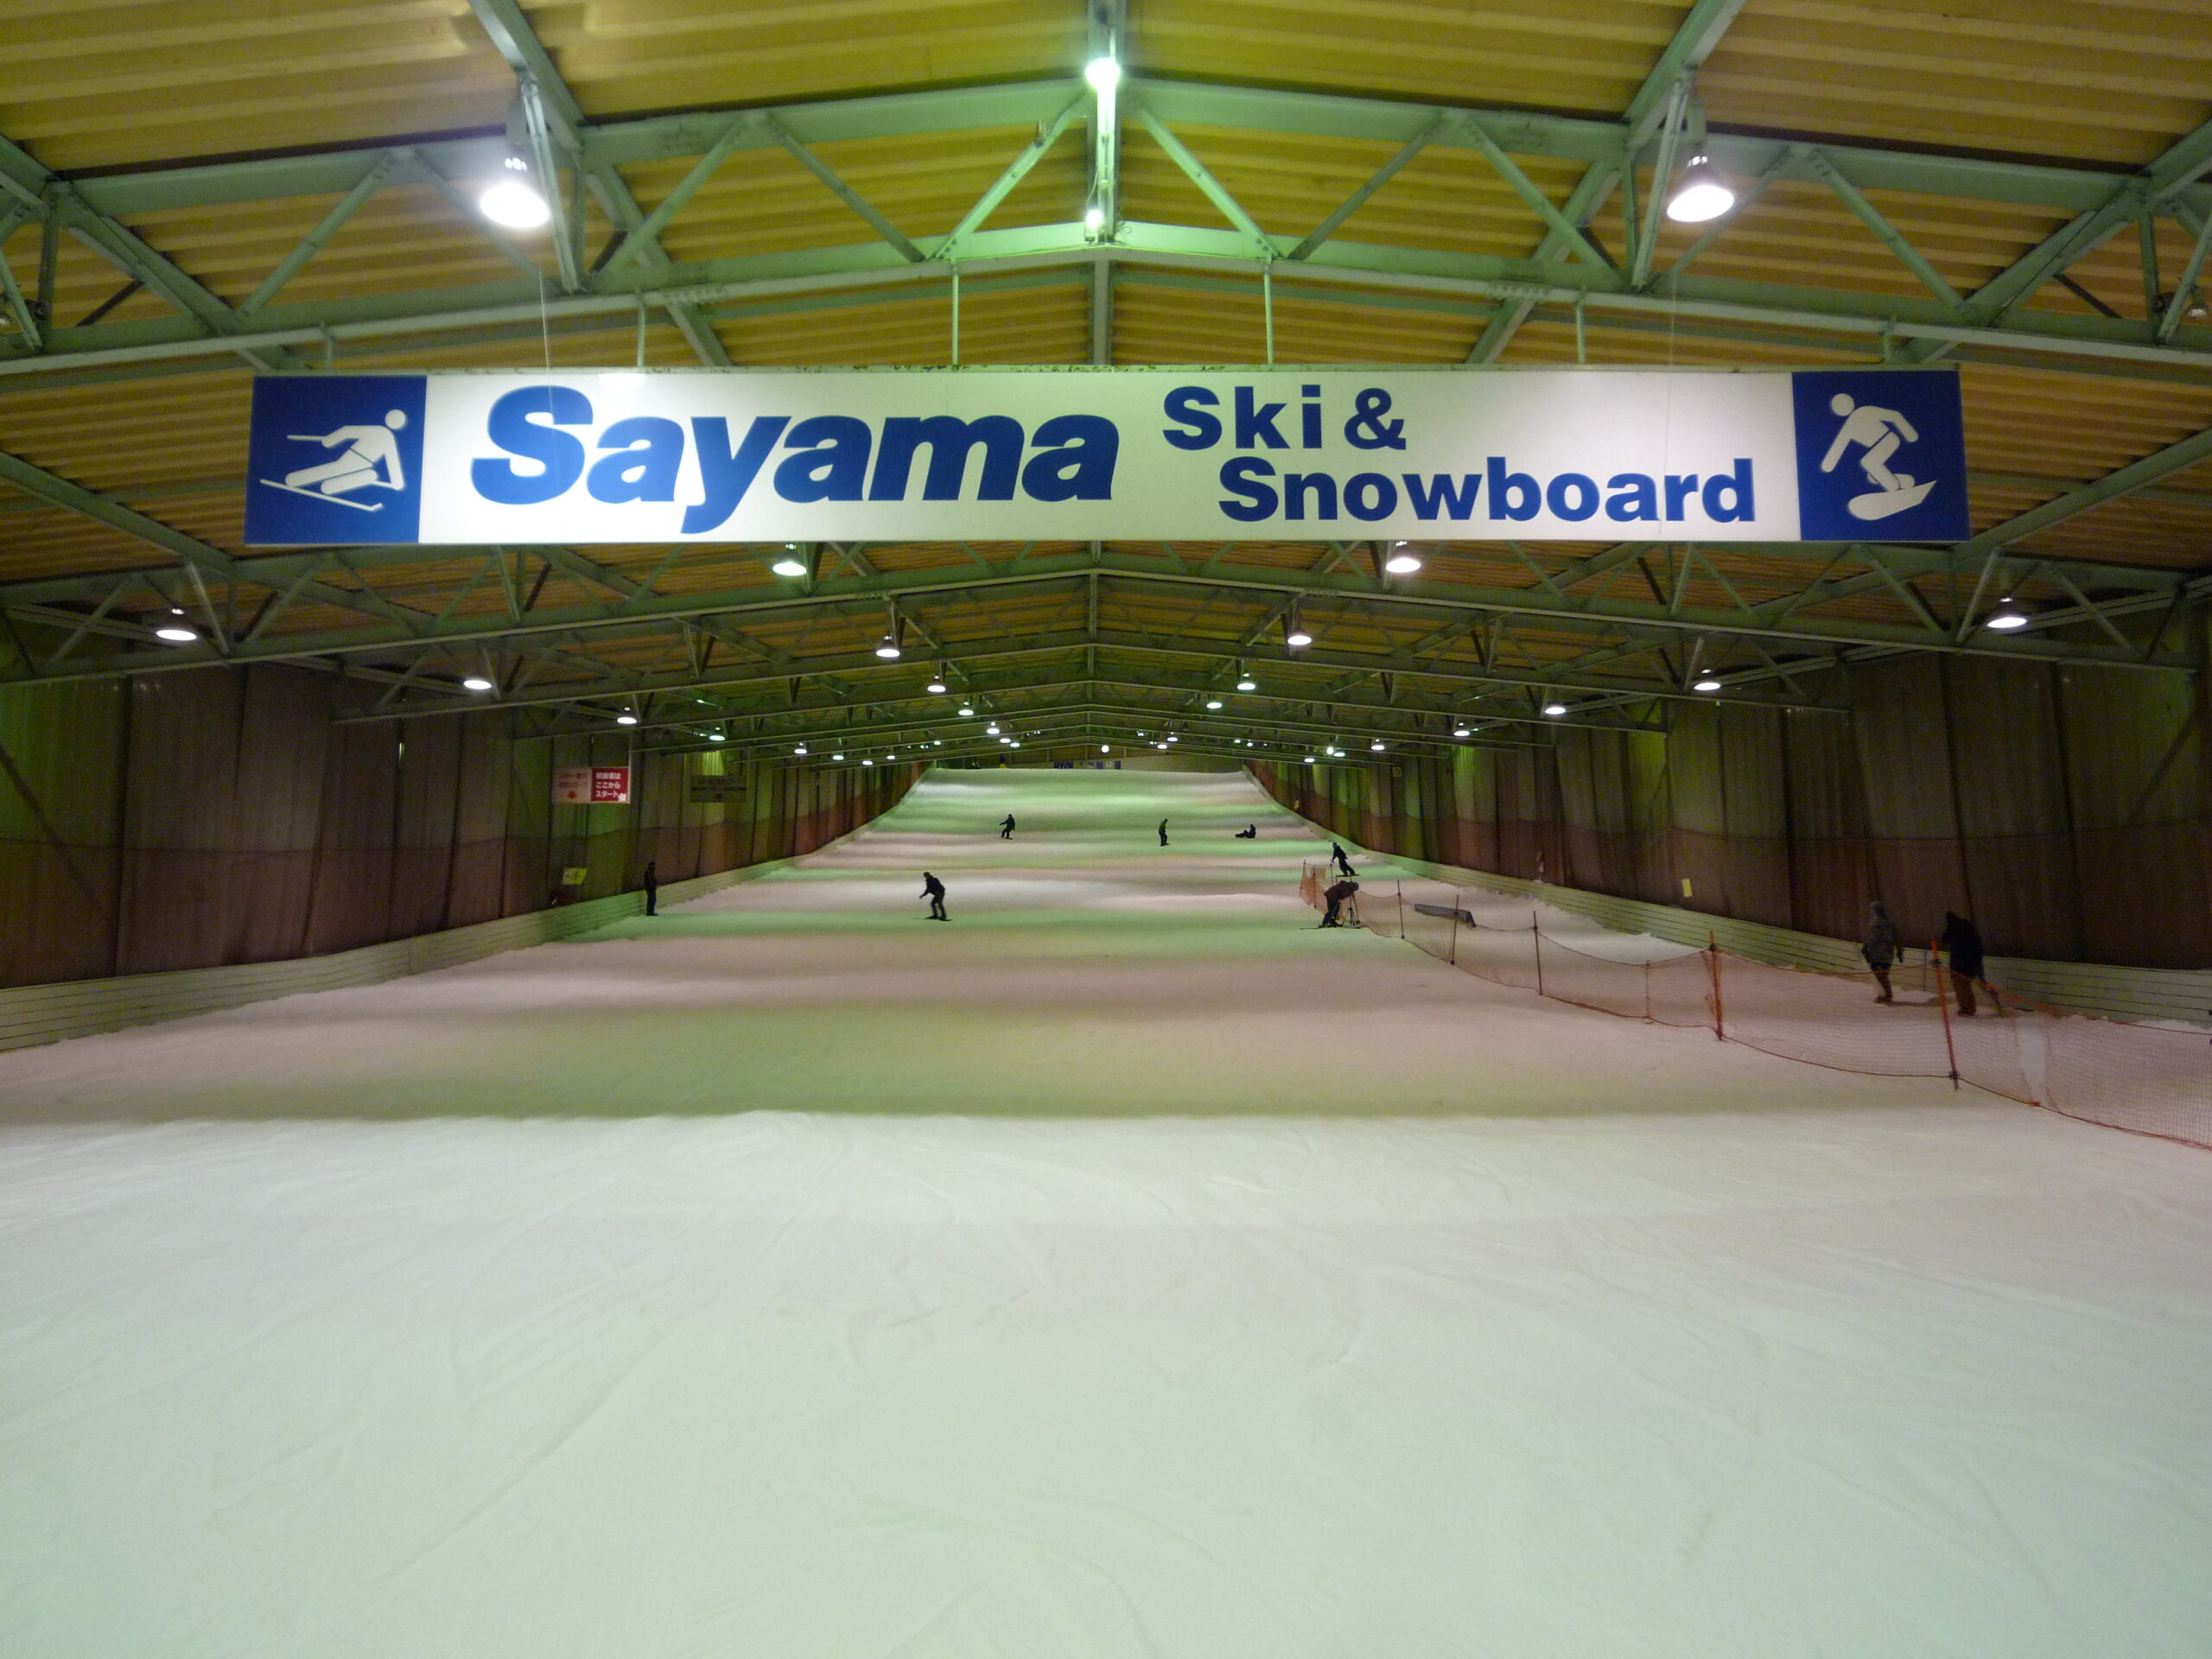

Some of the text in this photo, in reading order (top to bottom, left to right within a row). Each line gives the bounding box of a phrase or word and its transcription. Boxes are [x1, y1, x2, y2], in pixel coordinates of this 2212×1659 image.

[1164, 385, 1407, 450] Ski &
[472, 386, 1119, 533] Sayama
[1220, 457, 1756, 523] Snowboard
